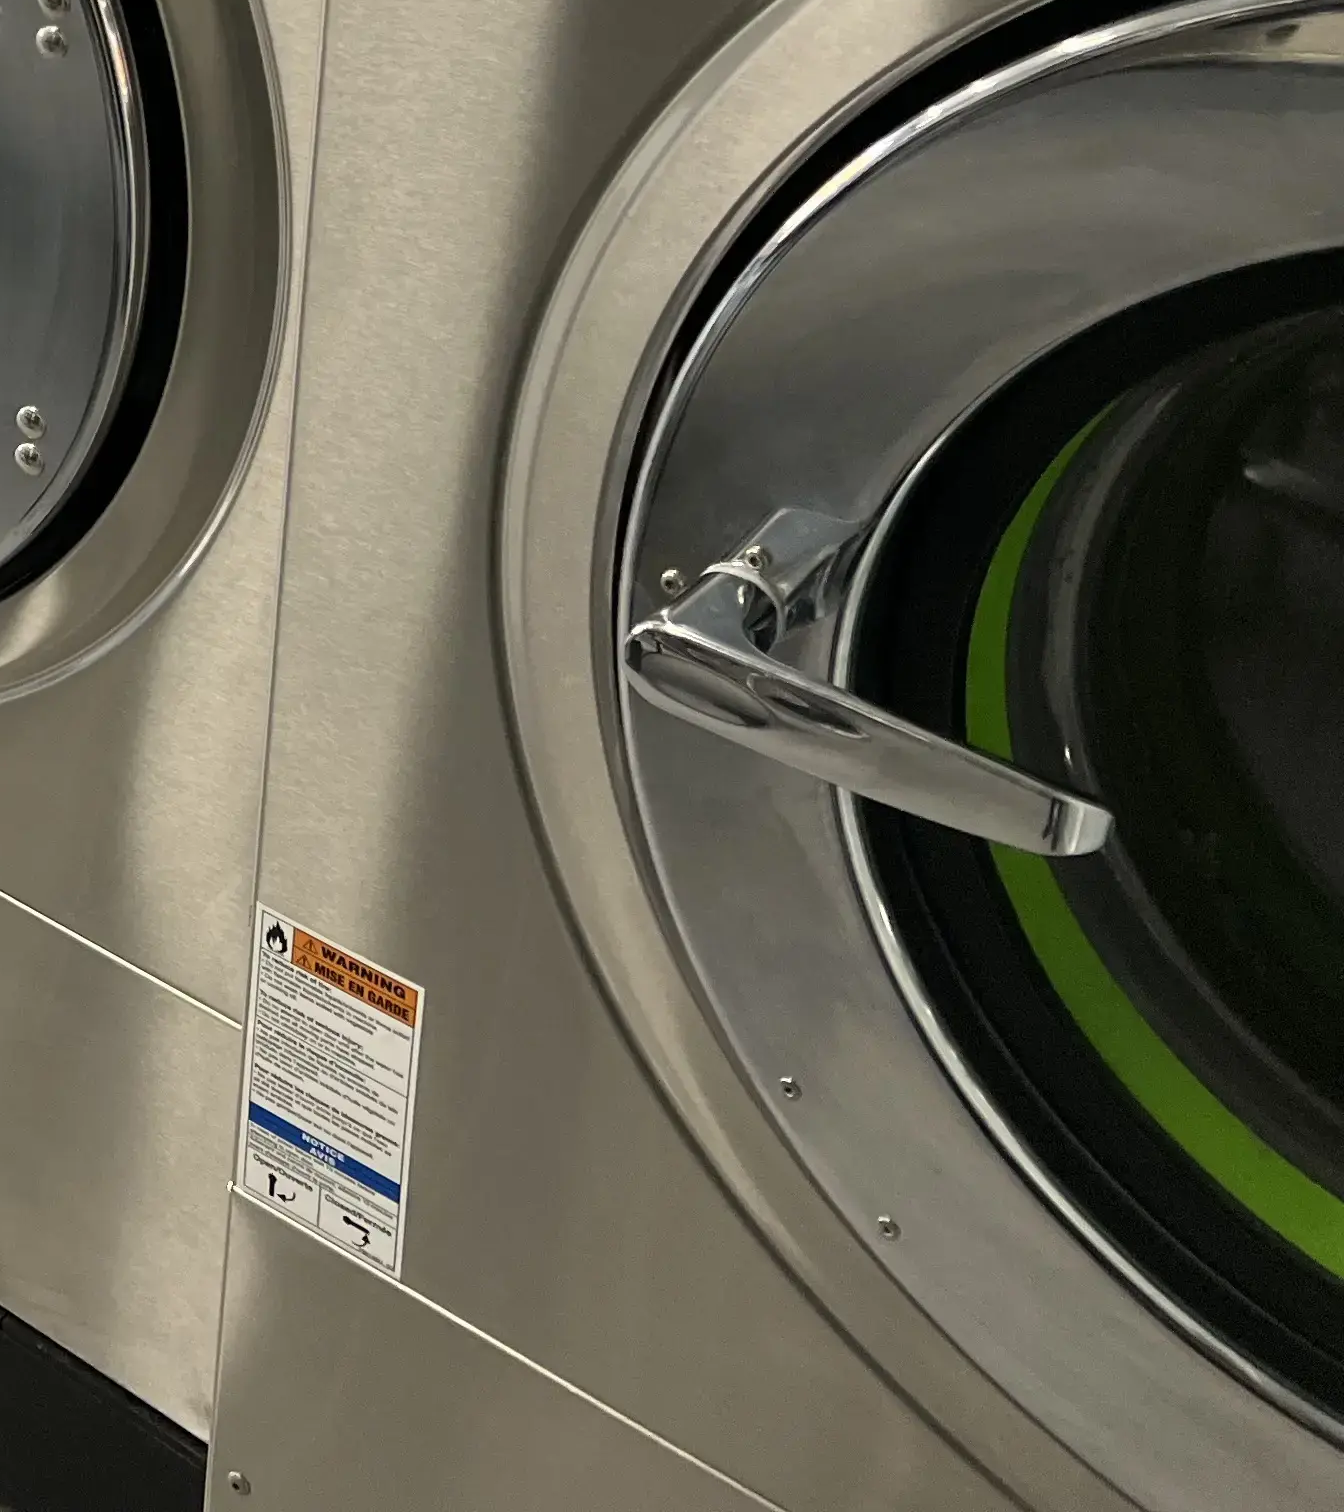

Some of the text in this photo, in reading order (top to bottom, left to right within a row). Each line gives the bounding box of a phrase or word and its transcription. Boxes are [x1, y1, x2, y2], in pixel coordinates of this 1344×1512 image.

[313, 960, 410, 1023] MISE EN GARDE
[320, 944, 406, 1001] WARNING
[300, 1130, 345, 1164] NOTICE
[308, 1144, 337, 1168] AVIS
